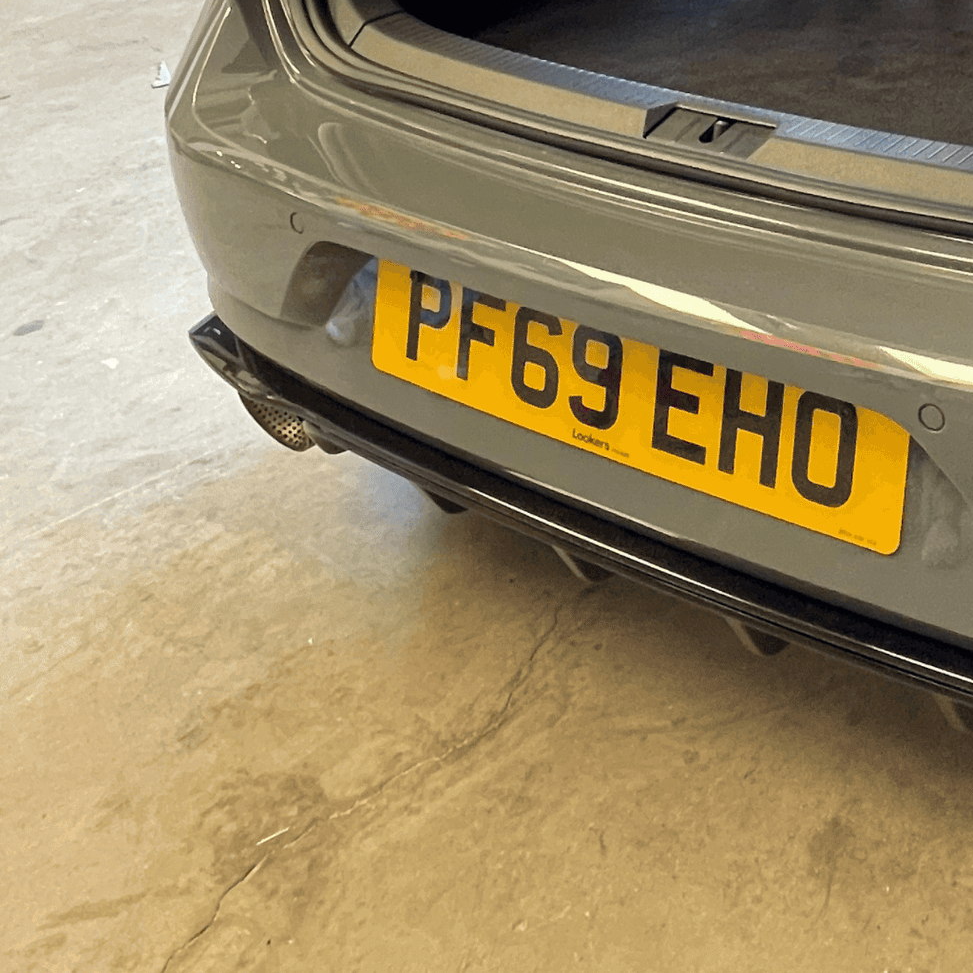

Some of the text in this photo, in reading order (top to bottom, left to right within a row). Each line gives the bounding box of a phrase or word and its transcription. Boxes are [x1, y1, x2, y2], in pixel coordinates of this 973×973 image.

[405, 270, 859, 509] PF69 EHO
[572, 428, 610, 450] Lookers
